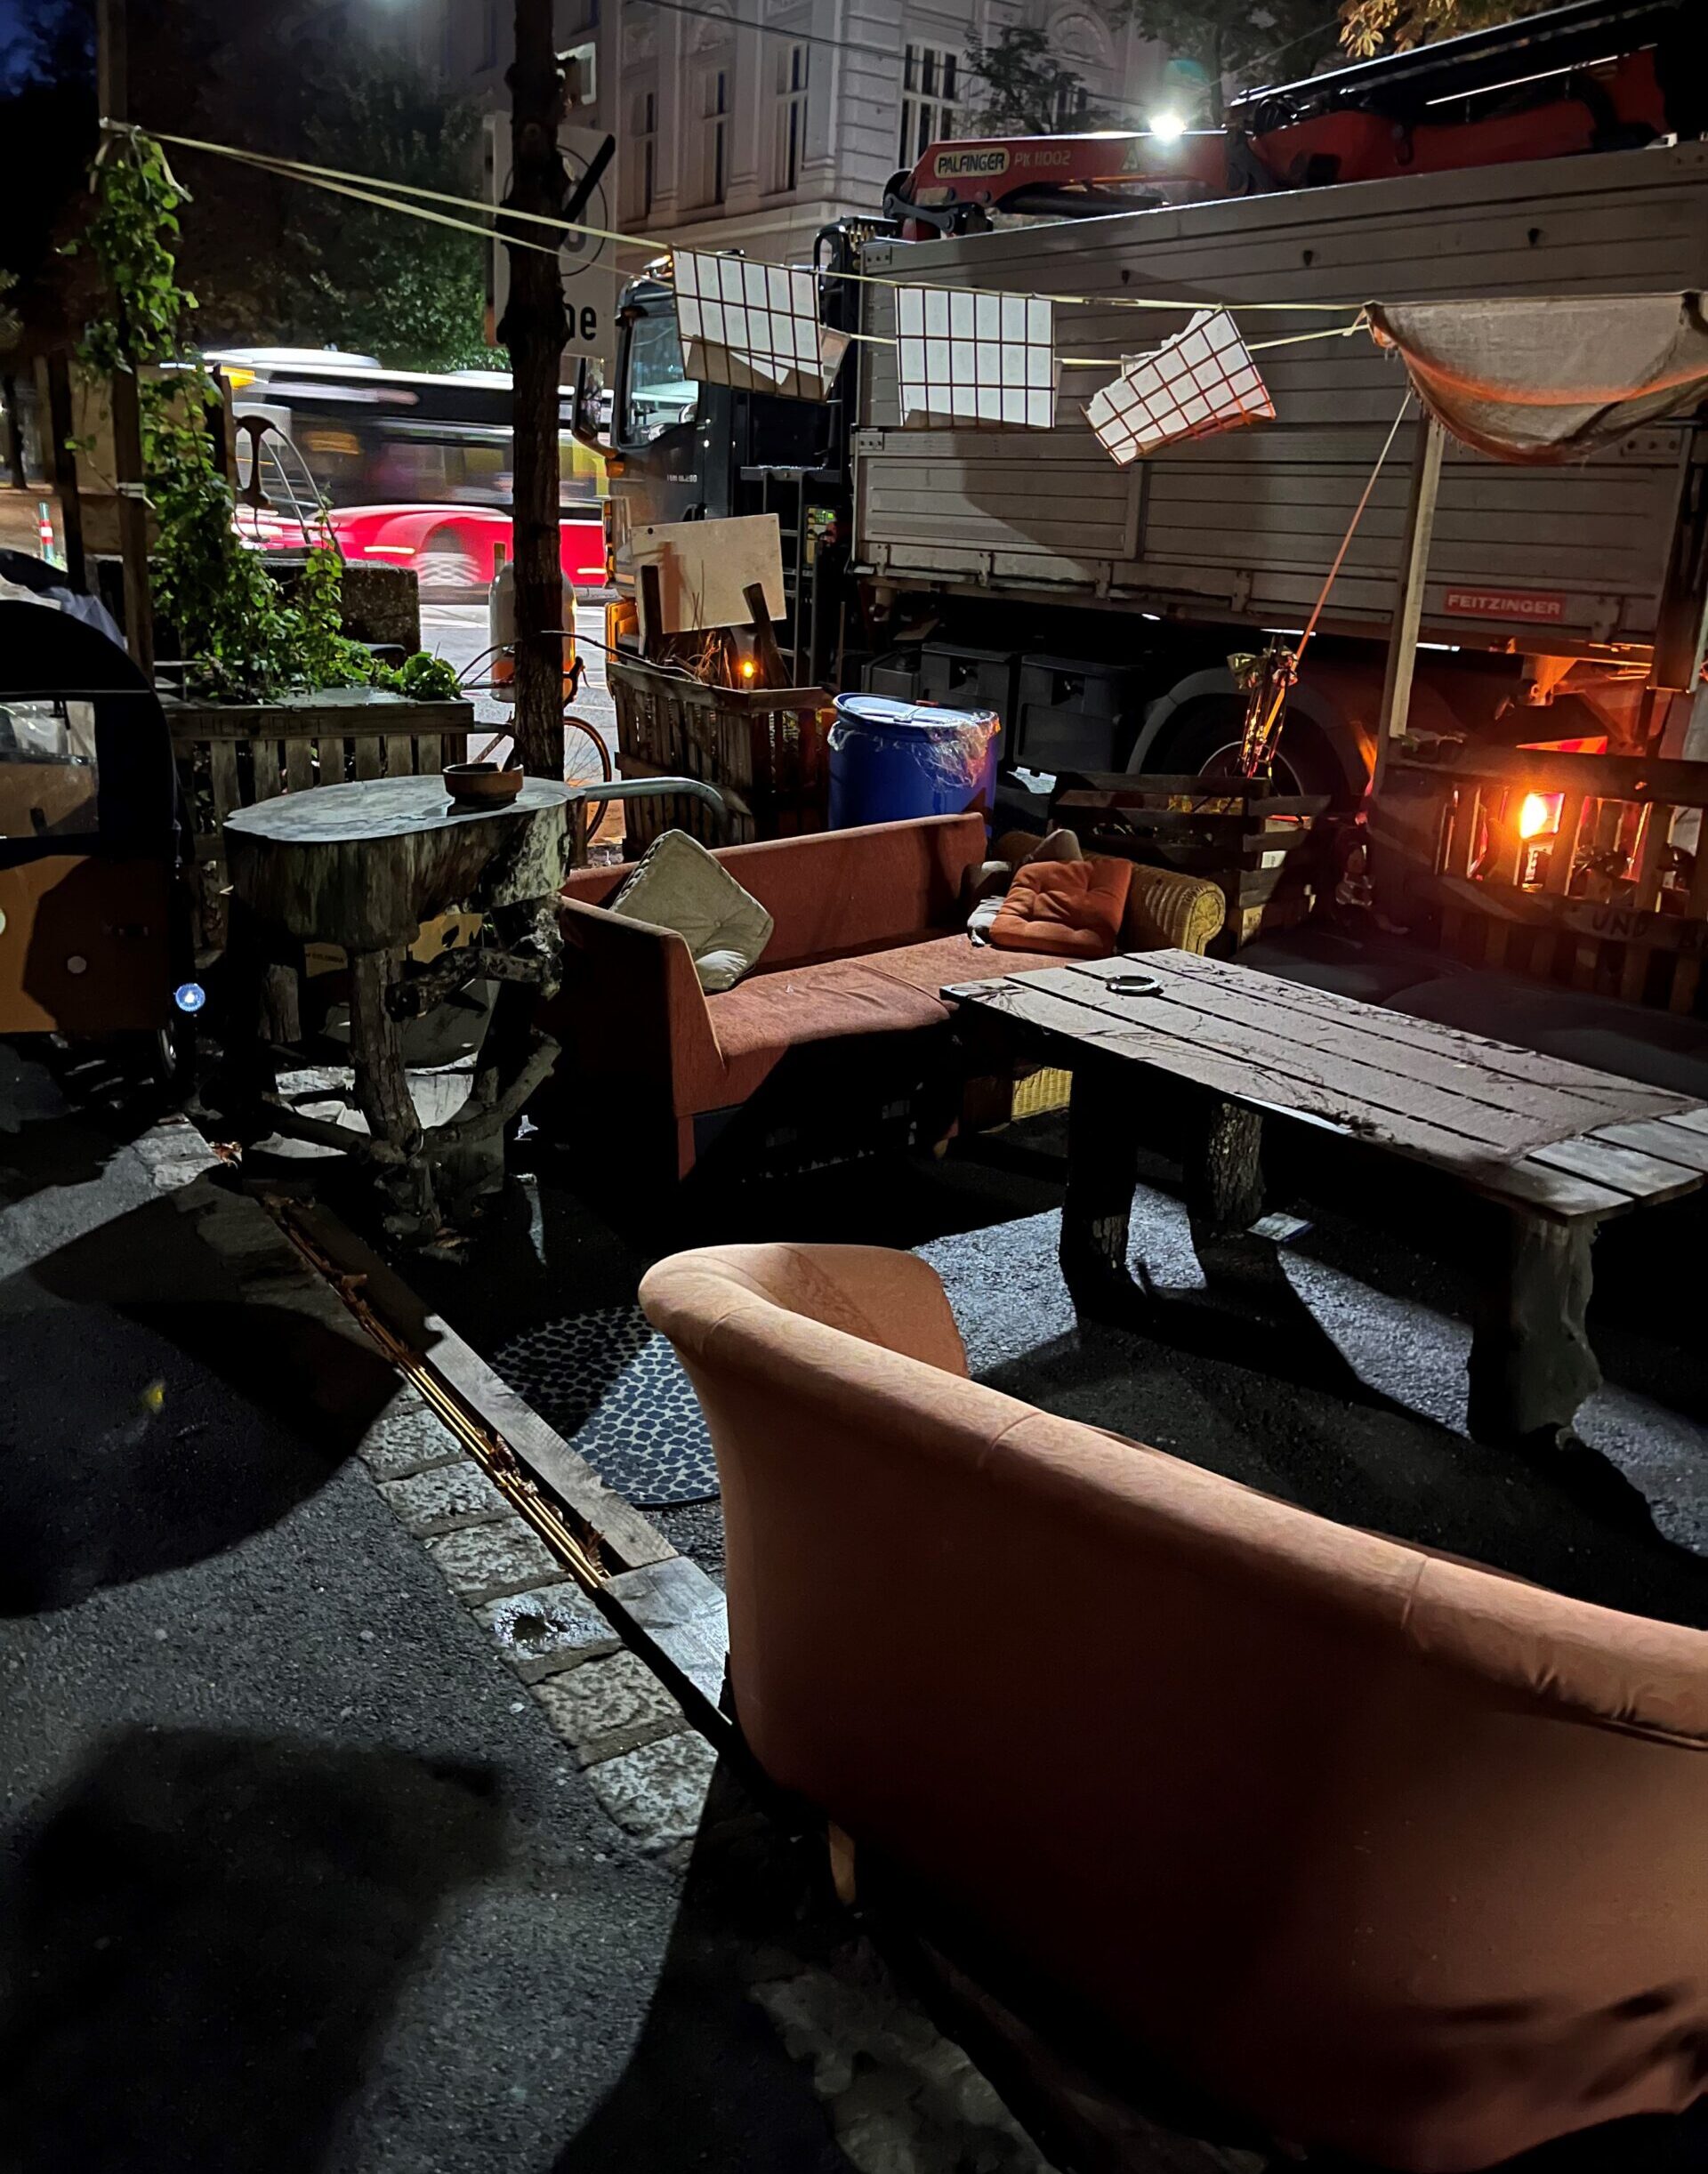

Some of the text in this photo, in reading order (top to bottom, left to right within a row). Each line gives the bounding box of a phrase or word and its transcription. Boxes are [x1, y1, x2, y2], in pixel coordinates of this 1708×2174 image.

[938, 153, 1005, 174] PALFINGER
[1014, 152, 1031, 167] PK
[563, 303, 597, 342] ne
[1447, 594, 1561, 615] FEITZINGER
